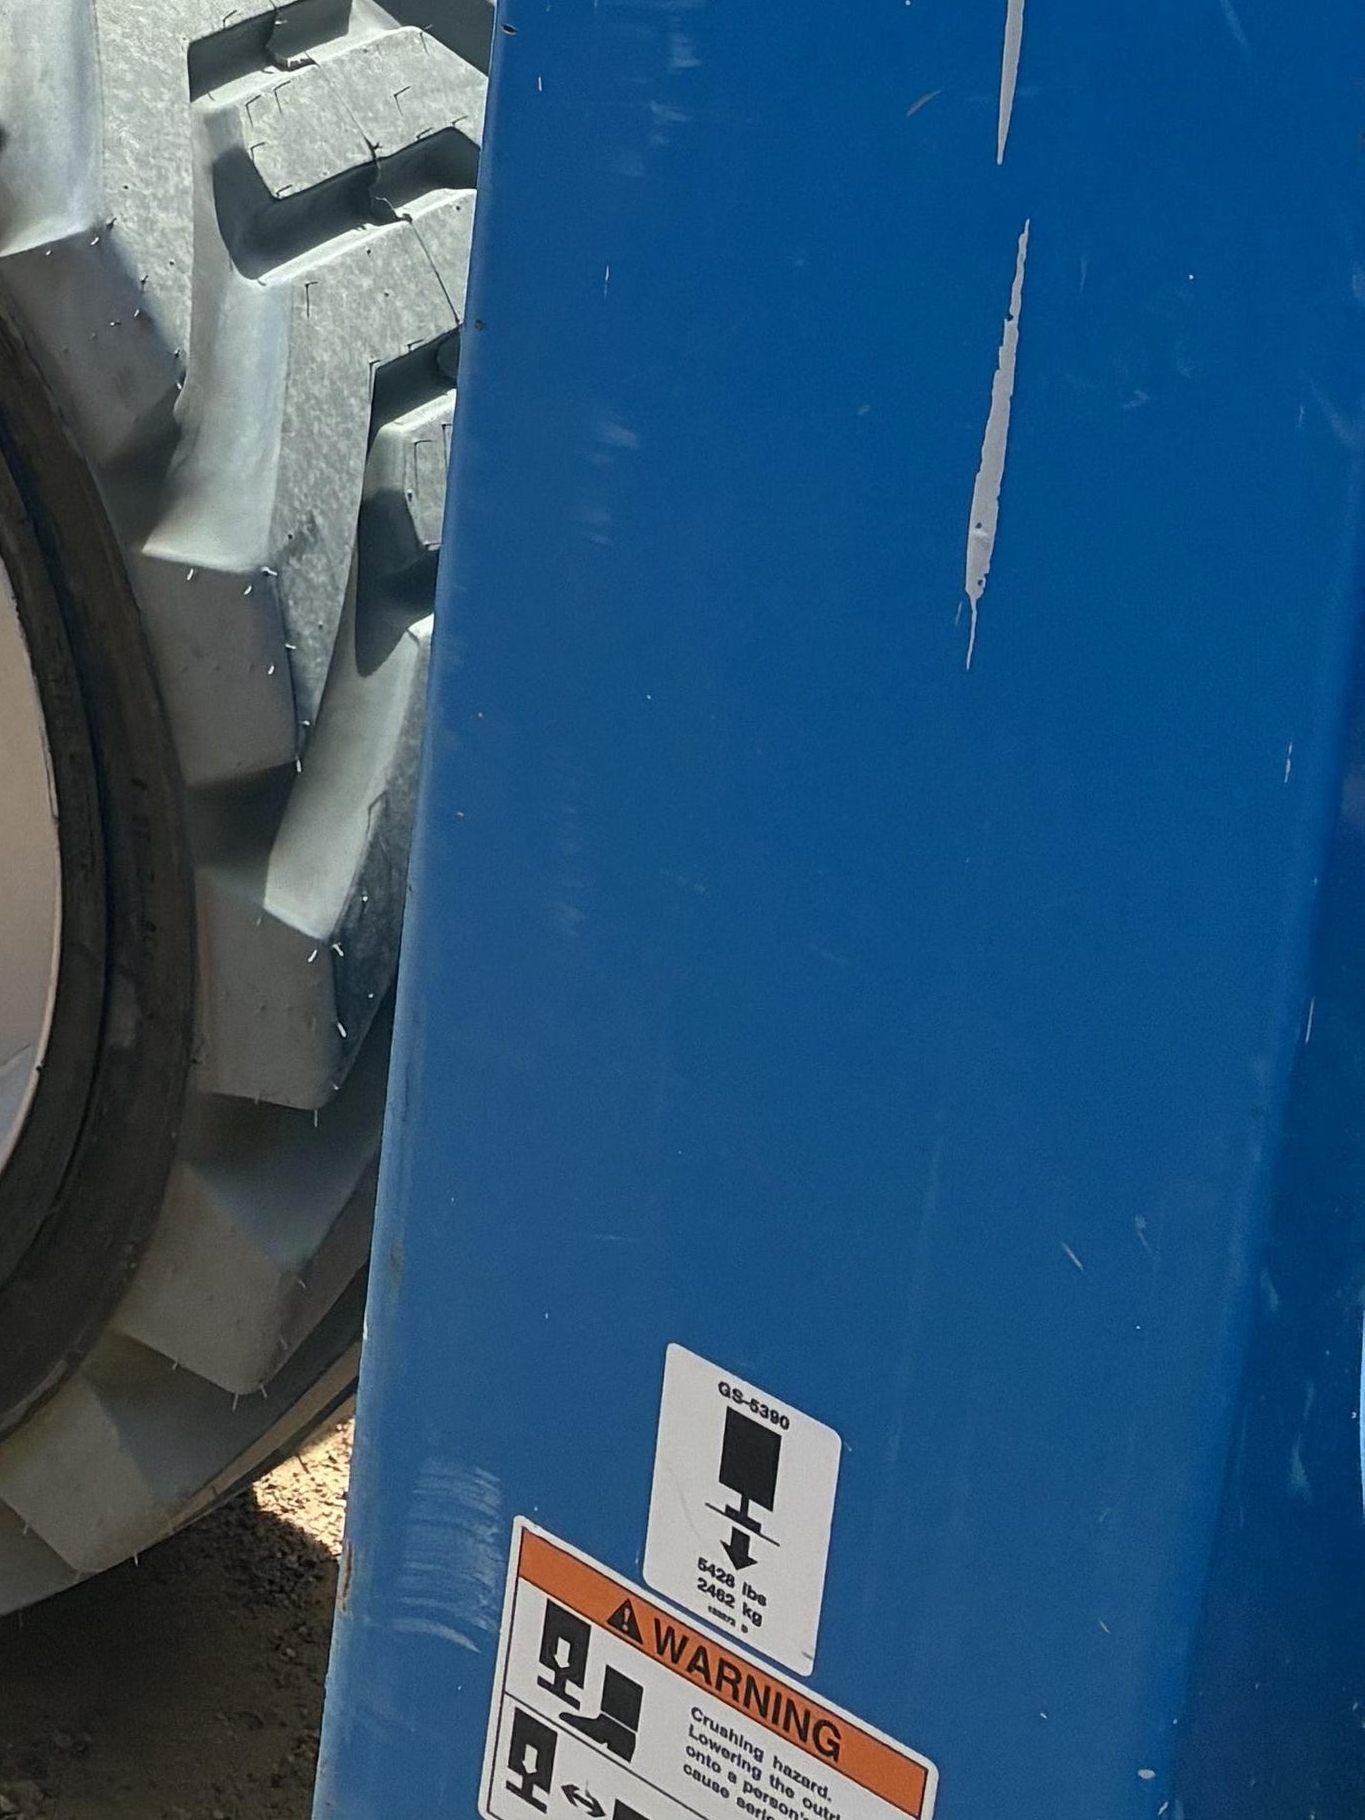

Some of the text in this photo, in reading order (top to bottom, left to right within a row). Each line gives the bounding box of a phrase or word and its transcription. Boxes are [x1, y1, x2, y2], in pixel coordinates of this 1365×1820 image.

[718, 1381, 790, 1431] GS-5390
[697, 1556, 767, 1607] 5428 lbs
[743, 1601, 763, 1627] kg
[653, 1617, 842, 1763] WARNING
[686, 1745, 720, 1773] onto
[728, 1772, 737, 1785] a
[689, 1724, 762, 1781] Lowering
[769, 1773, 795, 1799] the
[690, 1707, 832, 1802] Crushing hazard.
[683, 1762, 729, 1799] cause
